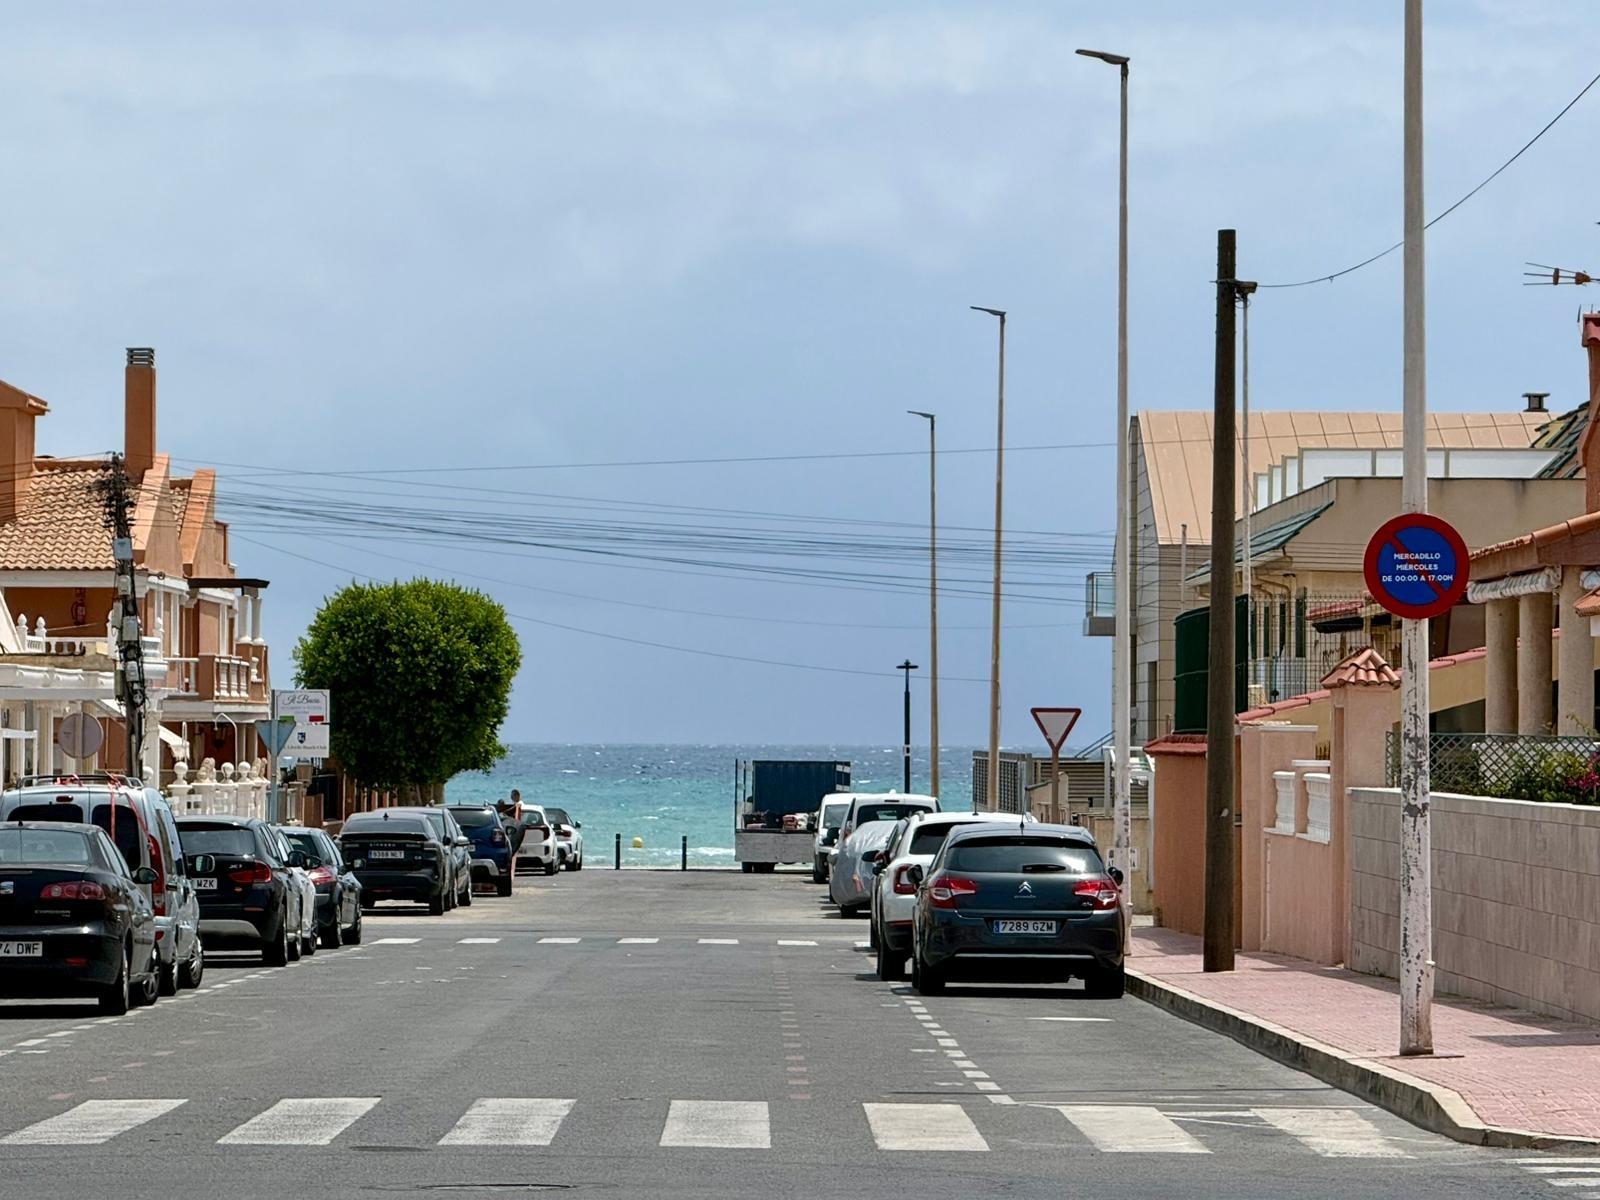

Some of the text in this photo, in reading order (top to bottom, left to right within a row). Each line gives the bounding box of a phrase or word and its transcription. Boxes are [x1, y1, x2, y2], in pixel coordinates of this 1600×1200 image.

[1393, 552, 1441, 560] MERCADILLO
[1395, 562, 1439, 571] MIÉRCOLES
[1001, 921, 1053, 932] 7289 GZM
[16, 942, 40, 955] DWF
